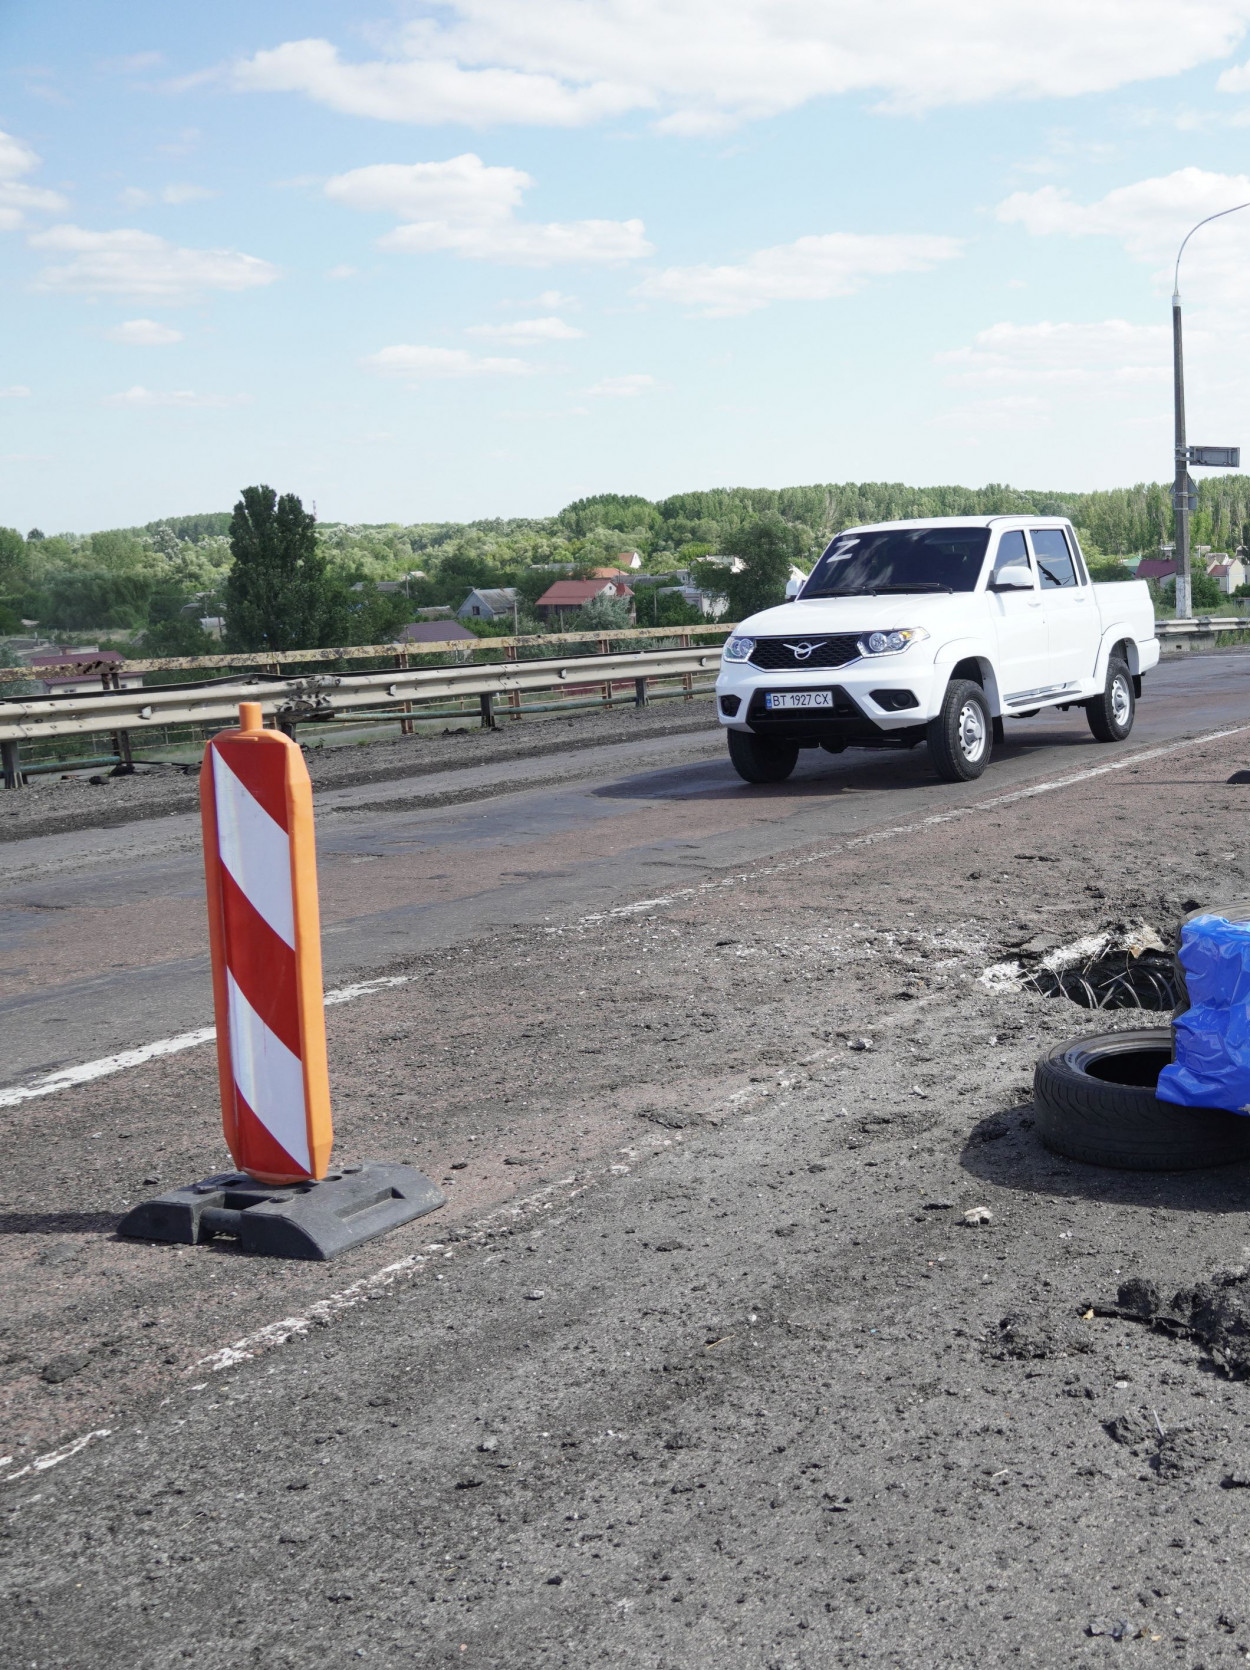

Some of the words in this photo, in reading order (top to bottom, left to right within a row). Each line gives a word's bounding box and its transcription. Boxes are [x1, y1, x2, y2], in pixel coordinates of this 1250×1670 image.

[826, 538, 861, 564] Z
[772, 695, 786, 707] BT
[790, 694, 812, 706] 1927
[814, 693, 829, 705] CX
